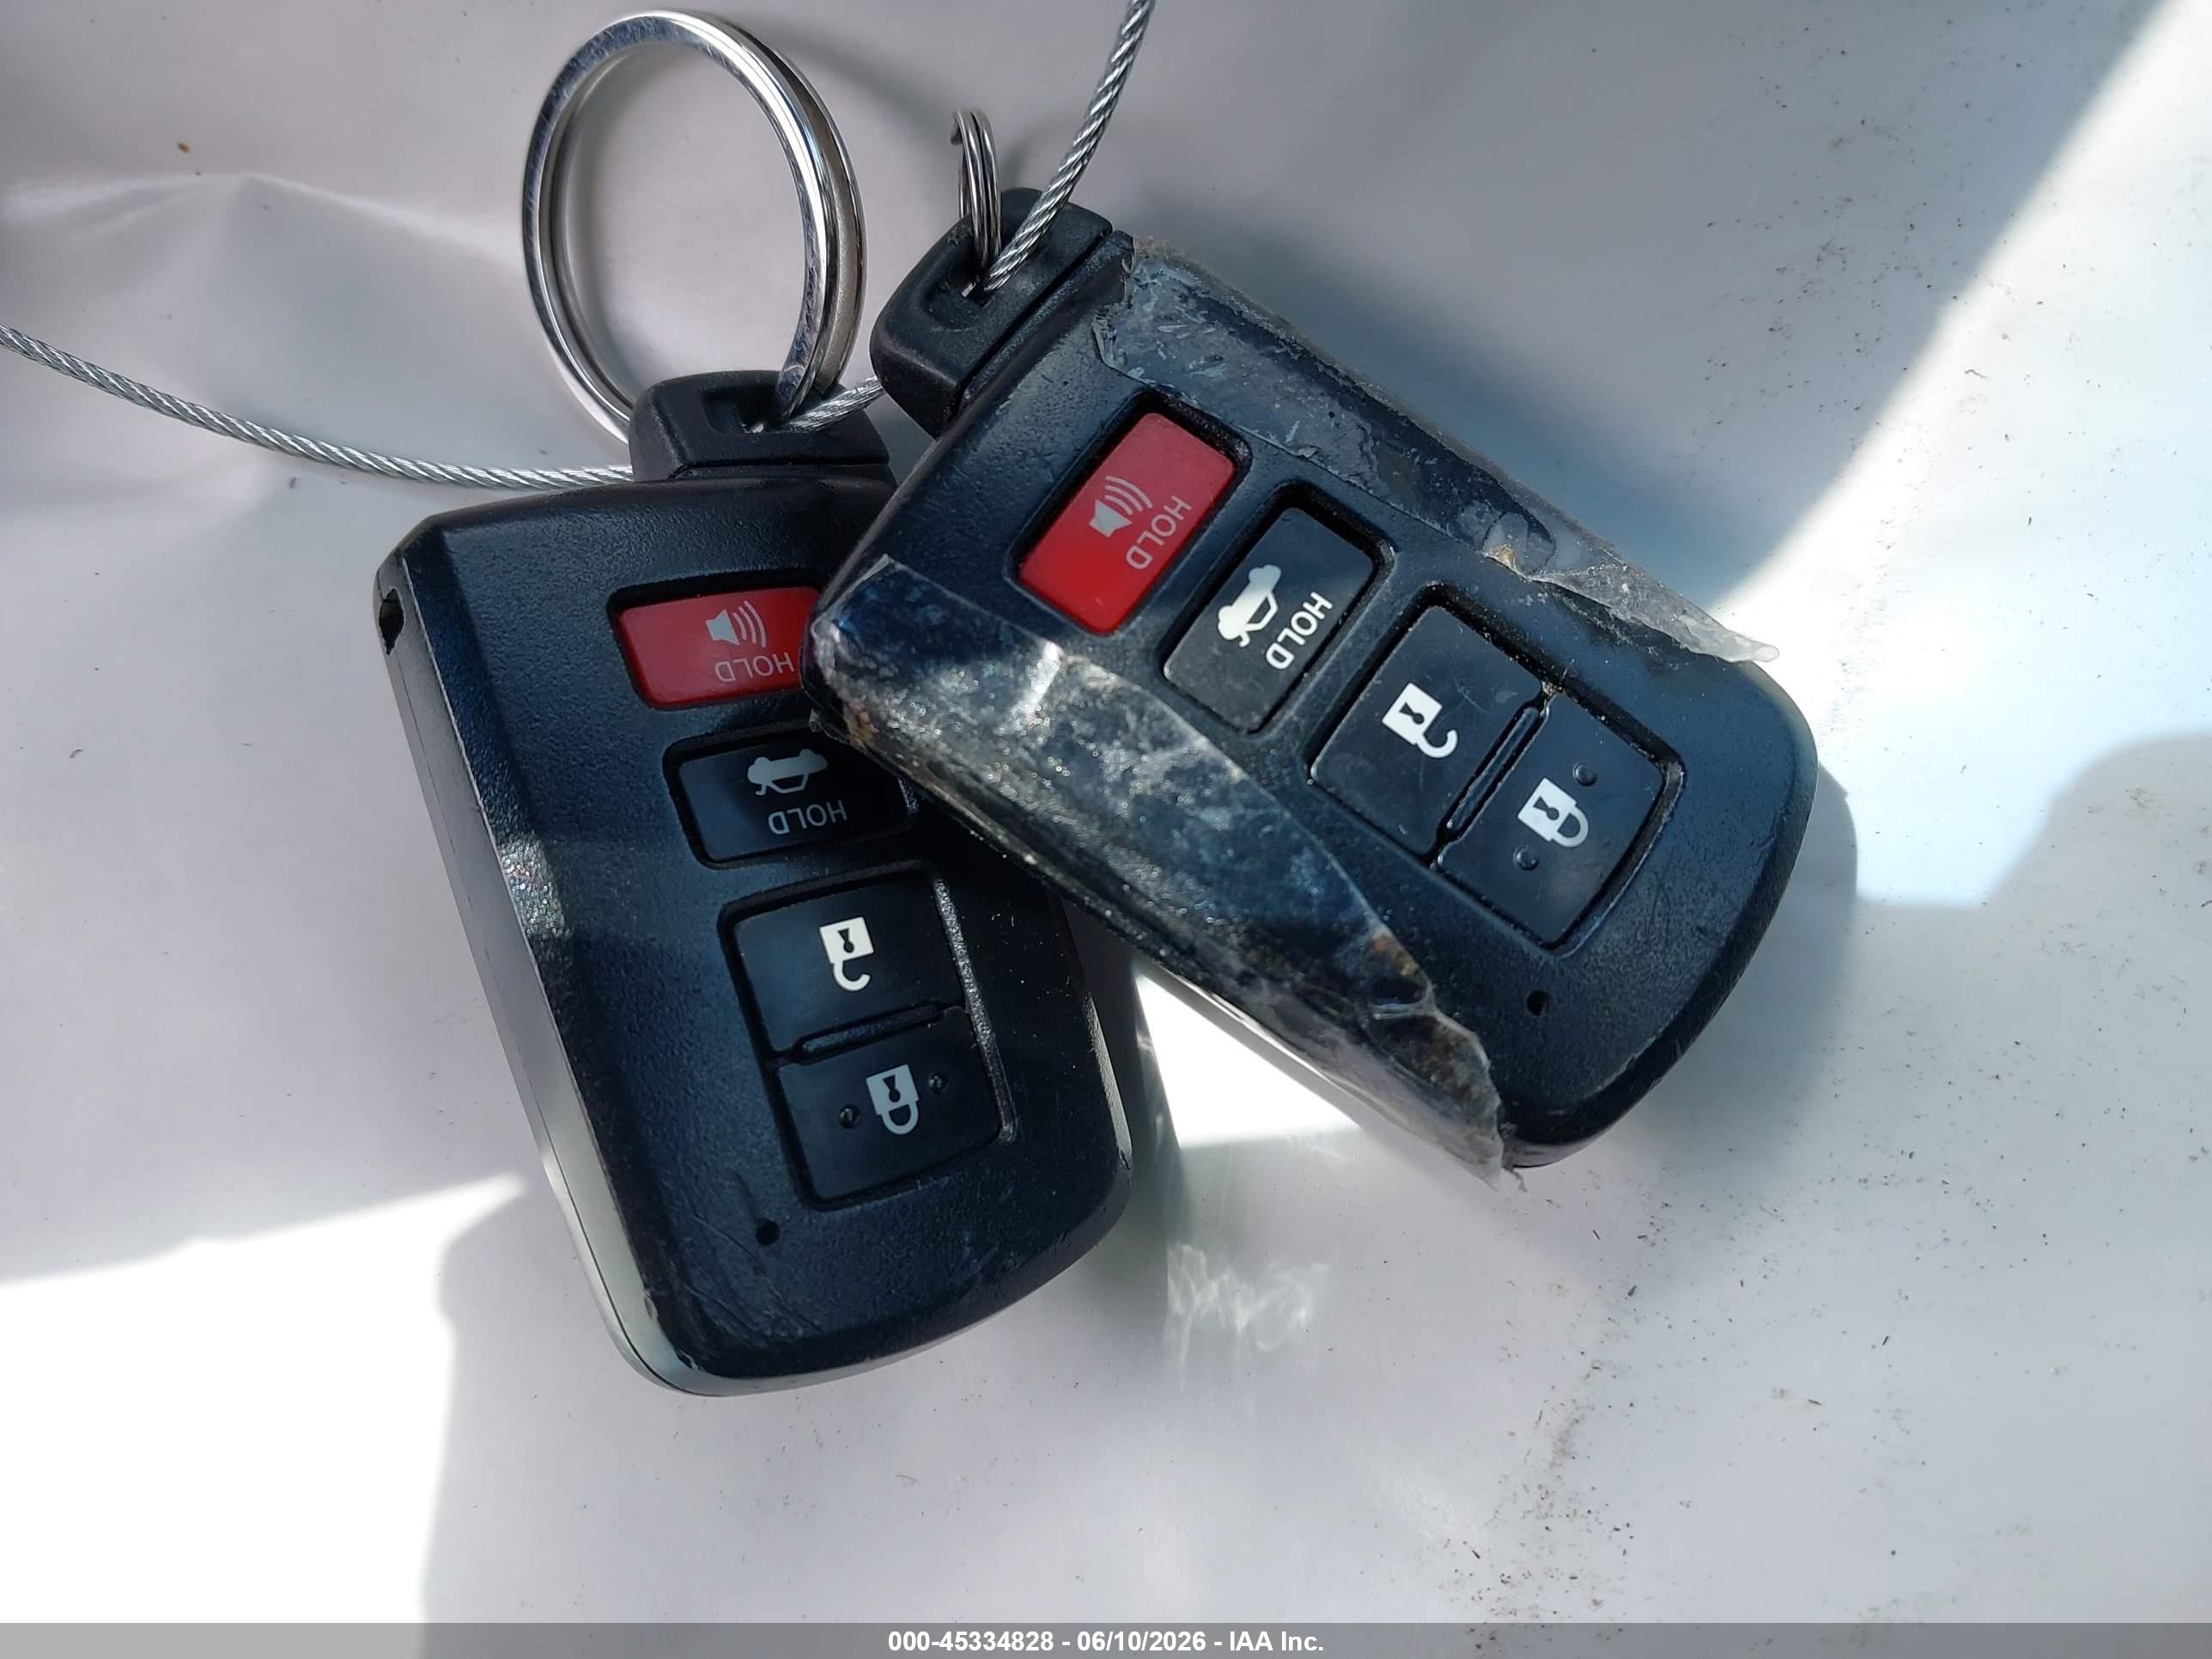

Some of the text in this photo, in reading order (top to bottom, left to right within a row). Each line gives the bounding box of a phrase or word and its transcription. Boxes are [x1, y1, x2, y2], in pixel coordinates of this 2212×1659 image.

[1127, 496, 1191, 568] HOLD
[1266, 592, 1333, 669] HOLD
[716, 653, 794, 682] HOLD
[769, 800, 847, 835] HOLD
